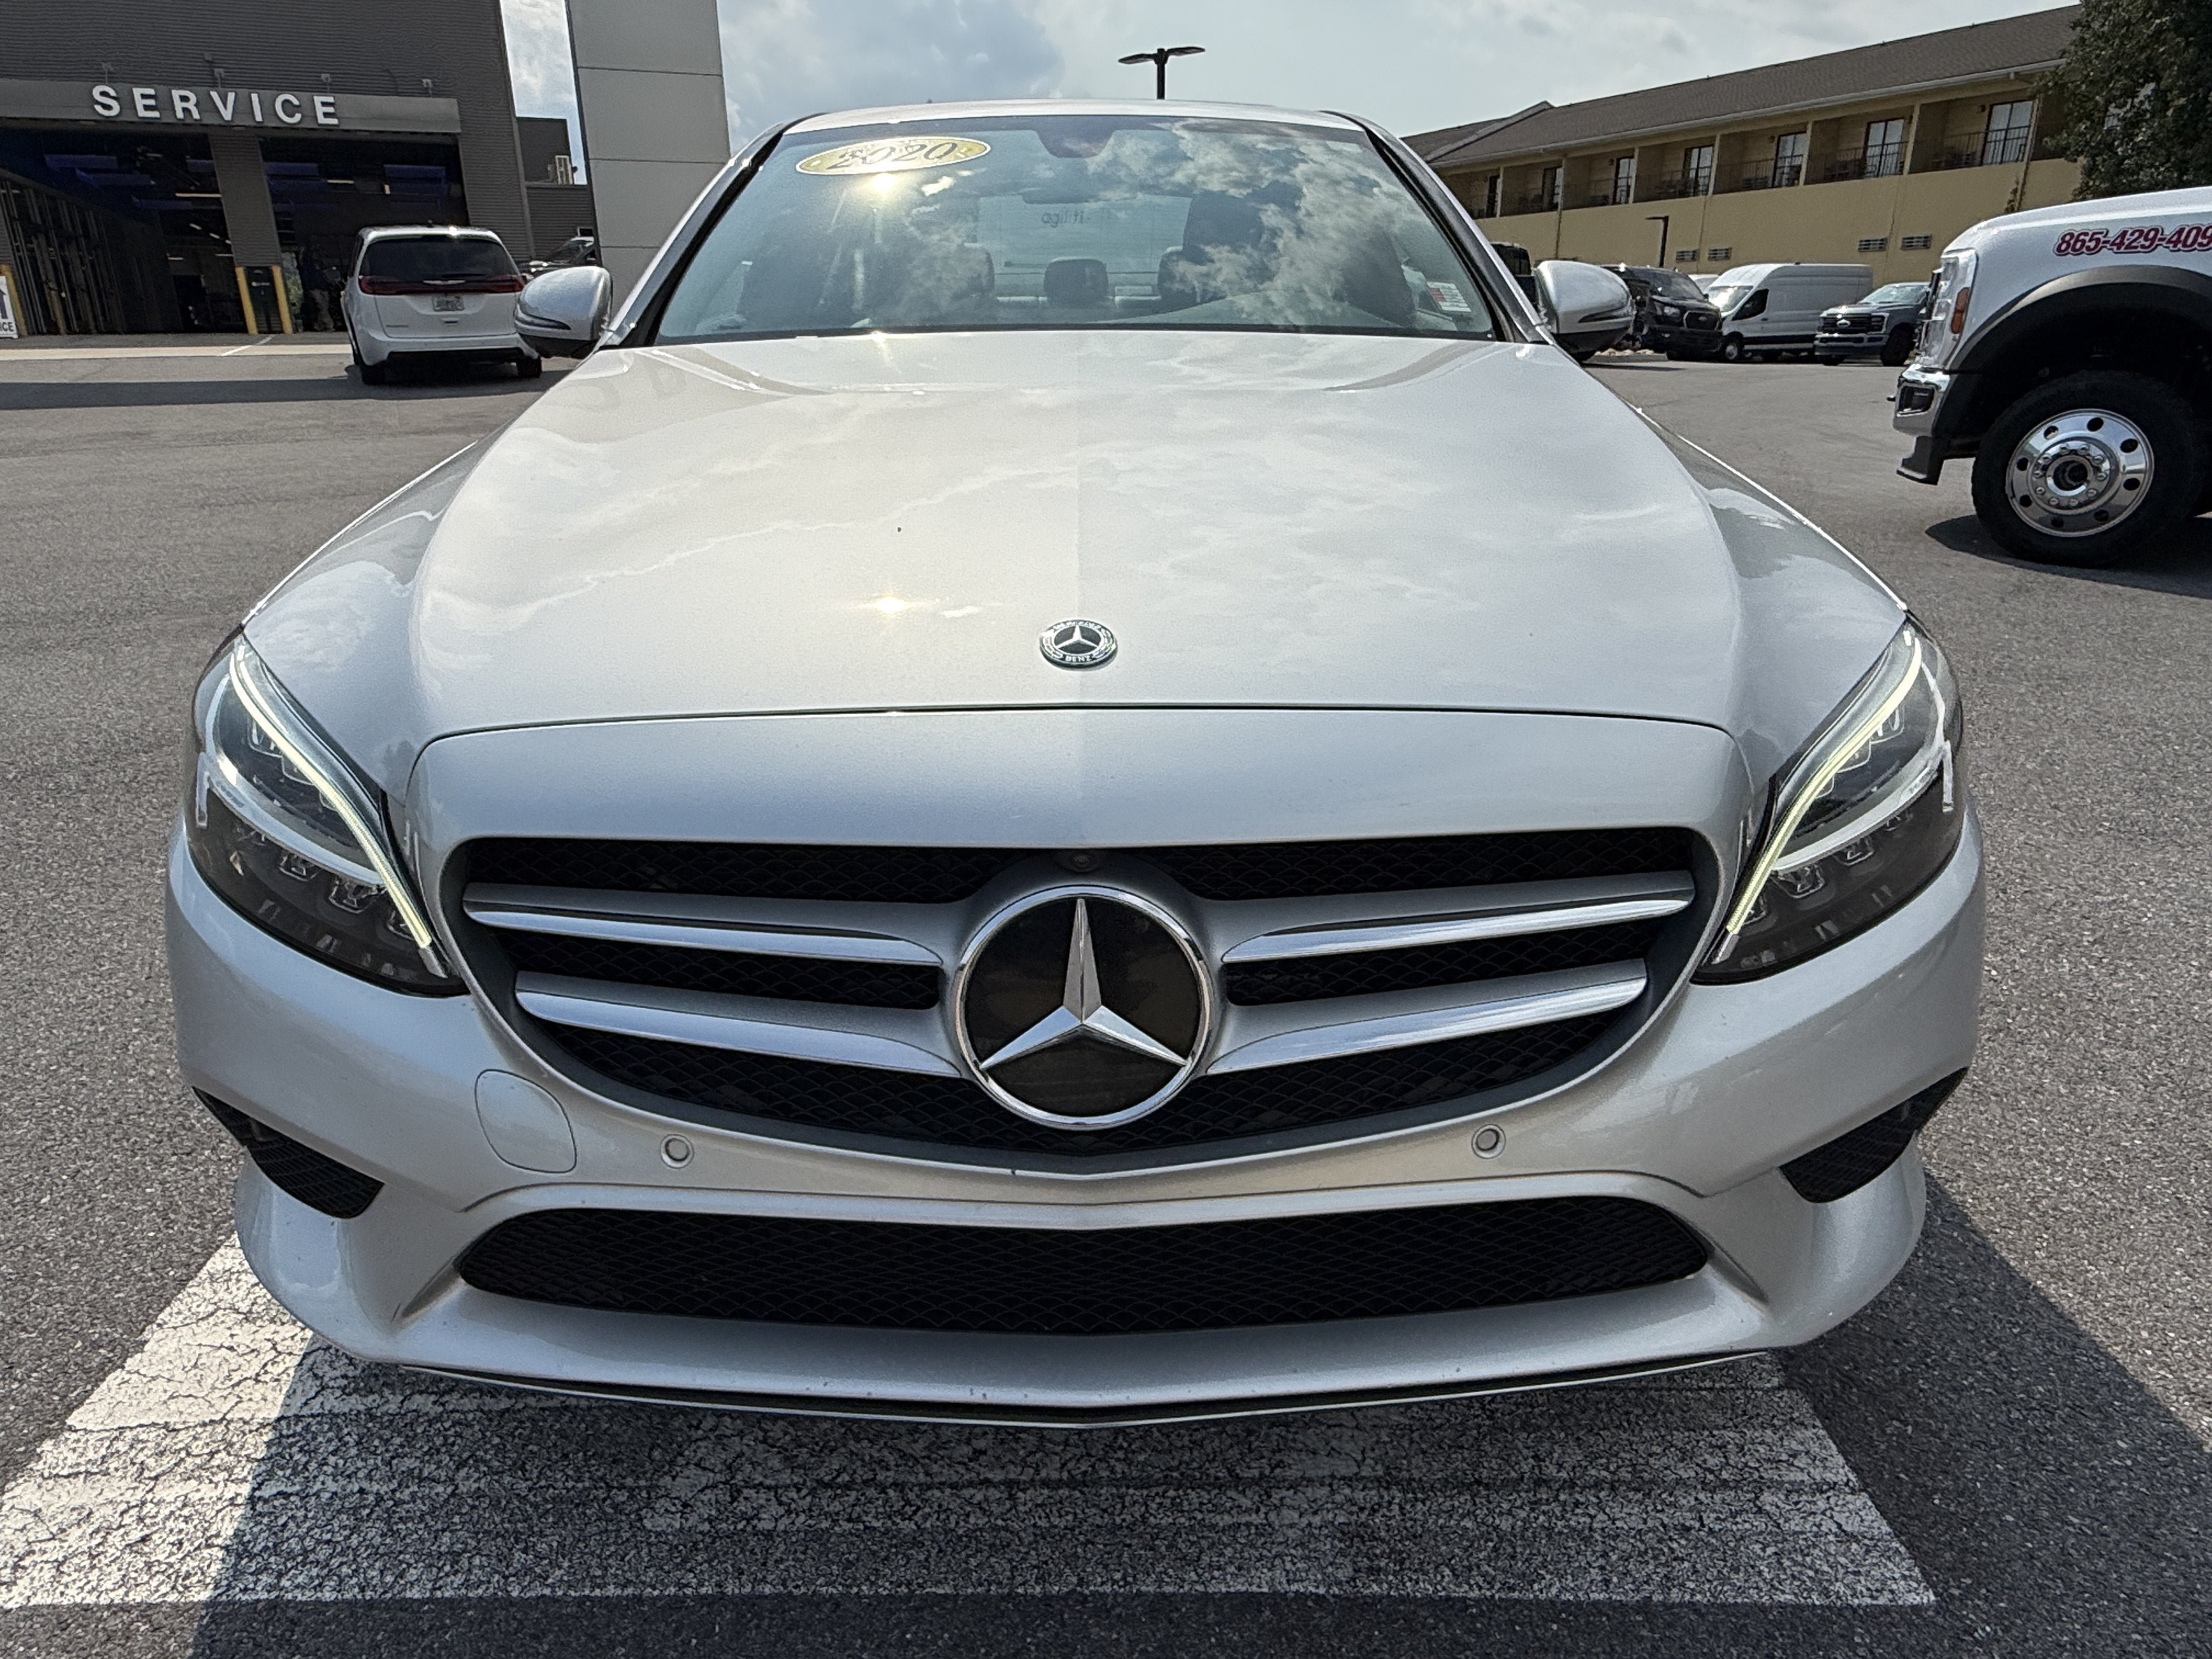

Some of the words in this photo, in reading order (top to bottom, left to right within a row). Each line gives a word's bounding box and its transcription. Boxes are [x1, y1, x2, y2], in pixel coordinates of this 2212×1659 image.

[92, 84, 339, 125] SERVICE
[826, 143, 958, 171] 2020
[2053, 223, 2212, 256] 865-429-409
